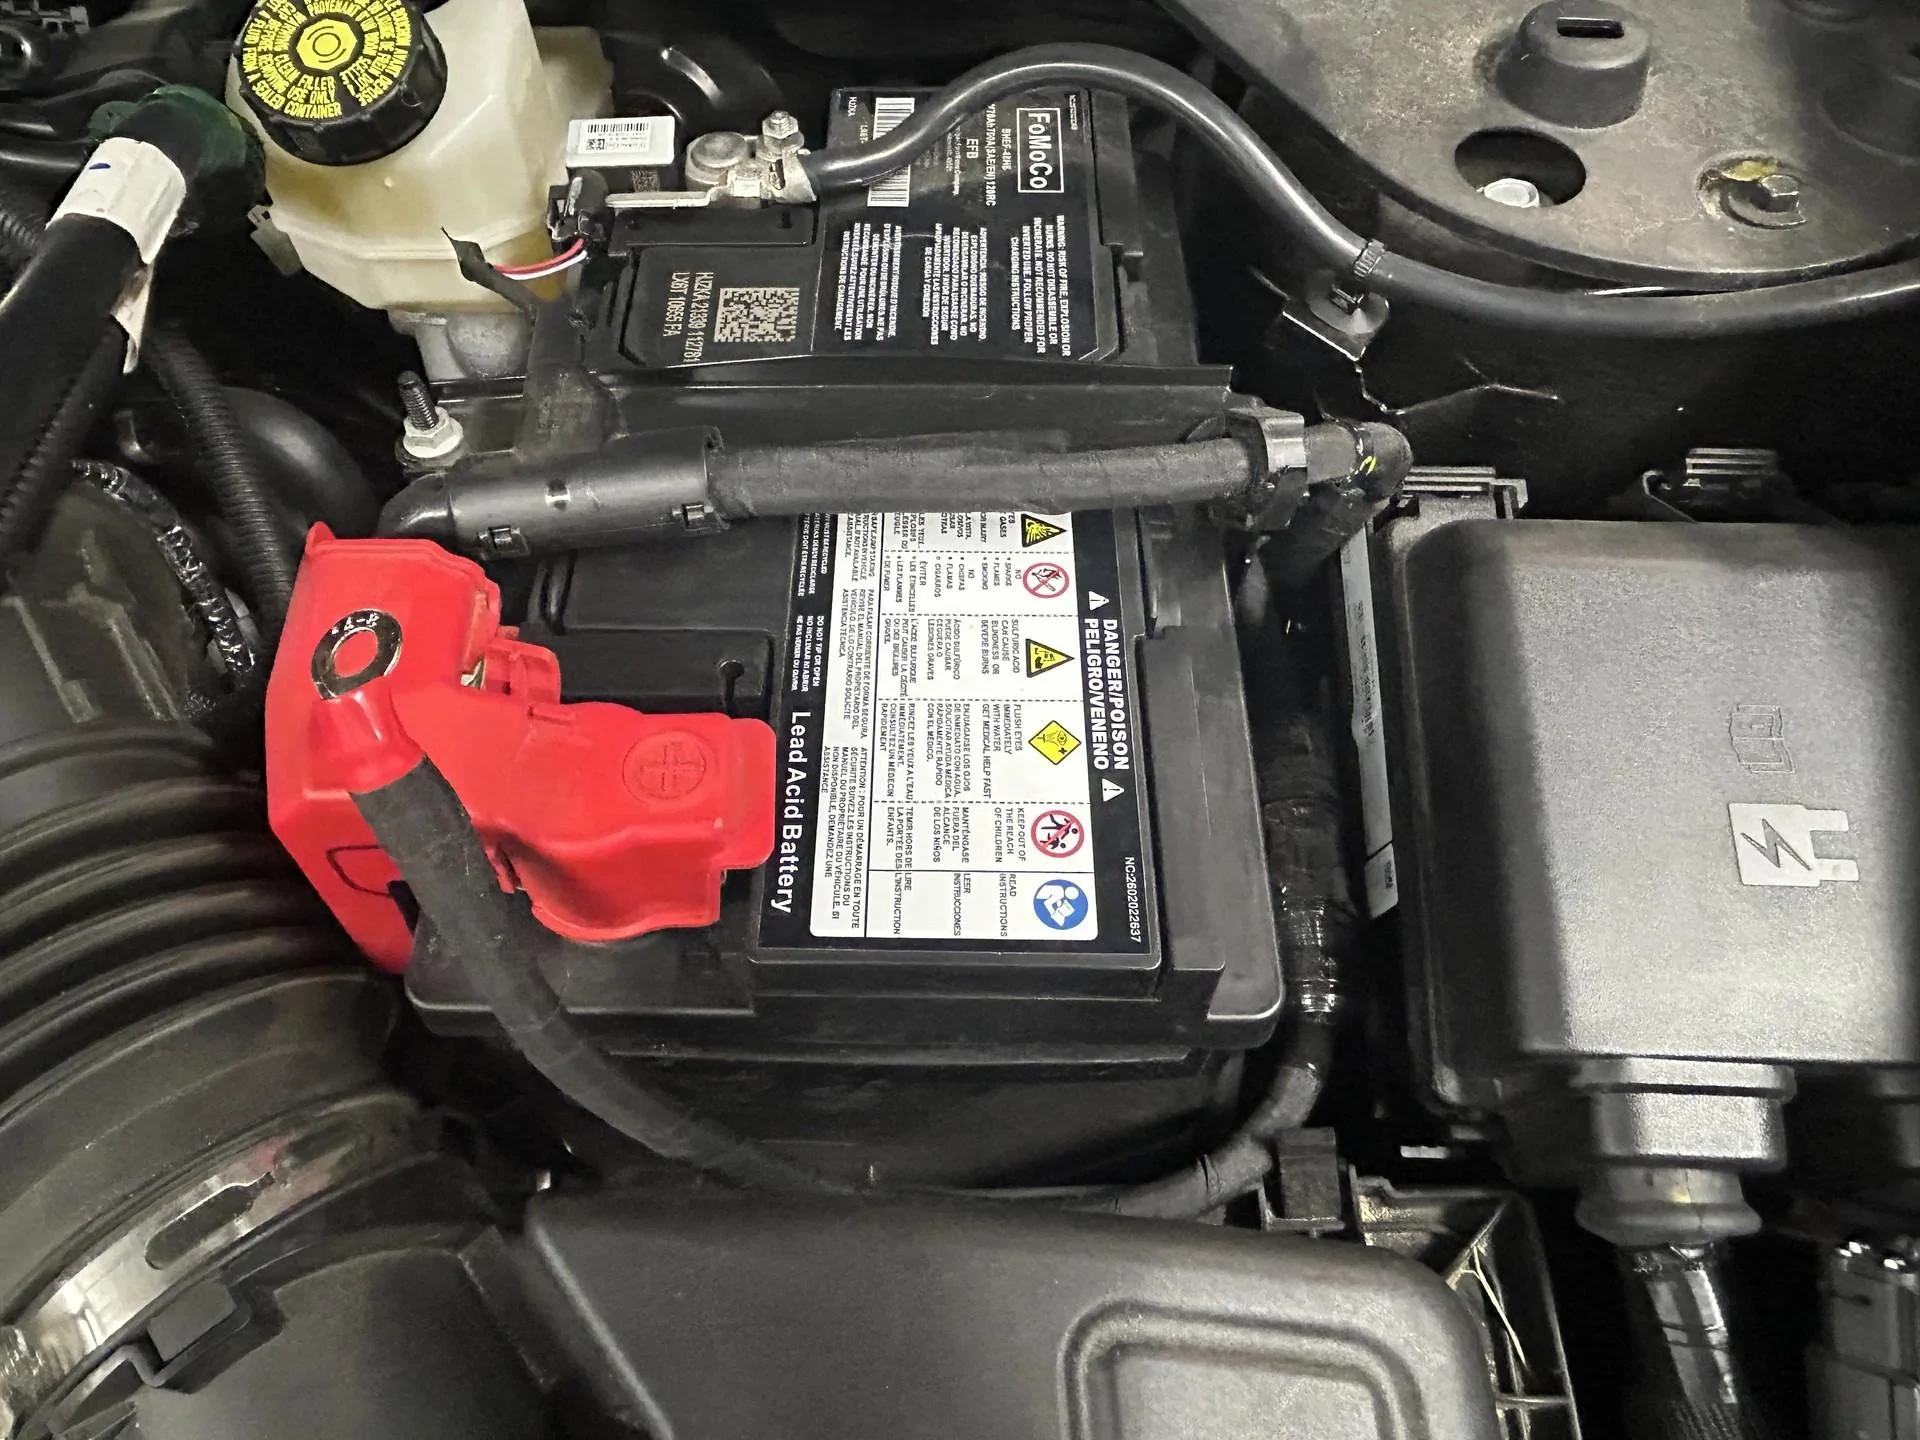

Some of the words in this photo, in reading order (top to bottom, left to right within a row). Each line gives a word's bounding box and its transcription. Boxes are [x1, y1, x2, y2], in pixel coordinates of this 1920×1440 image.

[306, 0, 361, 18] PROVENANT
[244, 18, 267, 44] FLUID
[242, 47, 259, 73] FROM
[384, 47, 408, 78] AVANT
[247, 73, 261, 82] A
[273, 53, 301, 83] CLEAN
[298, 74, 335, 91] FILLER
[353, 73, 374, 92] DOT
[252, 81, 286, 110] SEALED
[286, 85, 308, 104] USE
[310, 88, 335, 104] ONLY
[357, 75, 393, 107] DEPOSE
[284, 102, 343, 119] CONTAINER
[966, 138, 979, 159] EFB
[1028, 112, 1053, 189] FoMoCo
[1010, 236, 1020, 274] CHARGING
[1046, 251, 1055, 262] DO
[1035, 260, 1044, 276] NOT
[1046, 263, 1055, 279] NOT
[1059, 268, 1068, 279] OF
[1011, 274, 1020, 331] INSTRUCTIONS
[1023, 278, 1032, 310] FOLLOW
[1035, 276, 1045, 336] RECOMMENDED
[1046, 279, 1057, 332] DISASSEMBLE
[662, 323, 683, 337] FA
[1024, 311, 1033, 343] PROPER
[1060, 299, 1070, 344] EXPLOSION
[1036, 336, 1046, 354] FOR
[1049, 333, 1058, 345] OR
[1061, 344, 1071, 357] OR
[817, 615, 825, 626] DO
[1001, 620, 1009, 636] CAN
[1011, 619, 1019, 654] SULFURIC
[815, 643, 823, 654] TIP
[1001, 637, 1010, 661] CAUSE
[814, 655, 822, 666] OR
[992, 663, 1000, 675] OR
[1012, 655, 1020, 673] ACID
[812, 666, 821, 687] OPEN
[1084, 618, 1109, 770] PELIGRO/VENENO
[1103, 619, 1129, 770] DANGER/POISON
[954, 703, 961, 713] DE
[982, 703, 990, 718] GET
[1014, 704, 1022, 729] FLUSH
[879, 703, 888, 752] RAPIDEMENT
[927, 720, 934, 729] EL
[1003, 704, 1013, 755] IMMEDIATELY
[788, 711, 811, 763] Lead
[907, 732, 915, 746] LES
[982, 720, 990, 754] MEDICAL
[993, 725, 1001, 752] WATER
[1014, 731, 1023, 751] EYES
[832, 746, 840, 762] NON
[840, 746, 848, 778] MANUEL
[888, 749, 895, 759] UN
[907, 747, 915, 768] YEUX
[821, 746, 831, 794] ASSISTANCE
[858, 747, 867, 788] ATTENTION
[983, 756, 991, 776] HELP
[840, 779, 847, 790] DU
[906, 777, 914, 800] L'EAU
[963, 770, 971, 792] OJOS
[983, 778, 991, 799] FAST
[783, 767, 807, 819] Acid
[847, 786, 856, 813] SUIVEZ
[857, 795, 865, 817] POUR
[896, 807, 904, 817] LA
[933, 806, 941, 818] DE
[994, 807, 1001, 818] OF
[1006, 808, 1014, 823] THE
[836, 792, 846, 849] PROPRIÉTAIRE
[846, 815, 855, 830] LES
[857, 820, 864, 830] UN
[933, 819, 941, 835] LOS
[942, 806, 950, 845] ALCANCE
[952, 807, 960, 833] FUERA
[1017, 807, 1025, 830] KEEP
[825, 814, 836, 859] DEMANDEZ
[896, 818, 905, 851] PORTÉE
[905, 832, 913, 855] HORS
[952, 835, 960, 851] DEL
[961, 807, 971, 863] MANTÉNGASE
[994, 820, 1003, 863] CHILDREN
[1006, 825, 1014, 854] REACH
[1017, 831, 1026, 848] OUT
[835, 851, 843, 863] DU
[853, 832, 864, 884] DÉMARRAGE
[895, 852, 903, 869] DES
[933, 837, 942, 863] NIÑOS
[1018, 850, 1026, 862] OF
[770, 824, 803, 913] Battery
[825, 860, 833, 877] UNE
[843, 832, 853, 892] INSTRUCTIONS
[905, 857, 913, 869] DE
[854, 886, 861, 898] EN
[904, 872, 912, 891] LIRE
[963, 873, 971, 894] LEER
[1009, 874, 1017, 897] READ
[842, 894, 850, 906] DU
[893, 872, 902, 935] L'INSTRUCTION
[953, 872, 961, 936] INSTRUCCIONES
[999, 873, 1008, 937] INSTRUCTIONS
[1124, 856, 1141, 943] NC:2602022637
[851, 900, 860, 929] TOUTE
